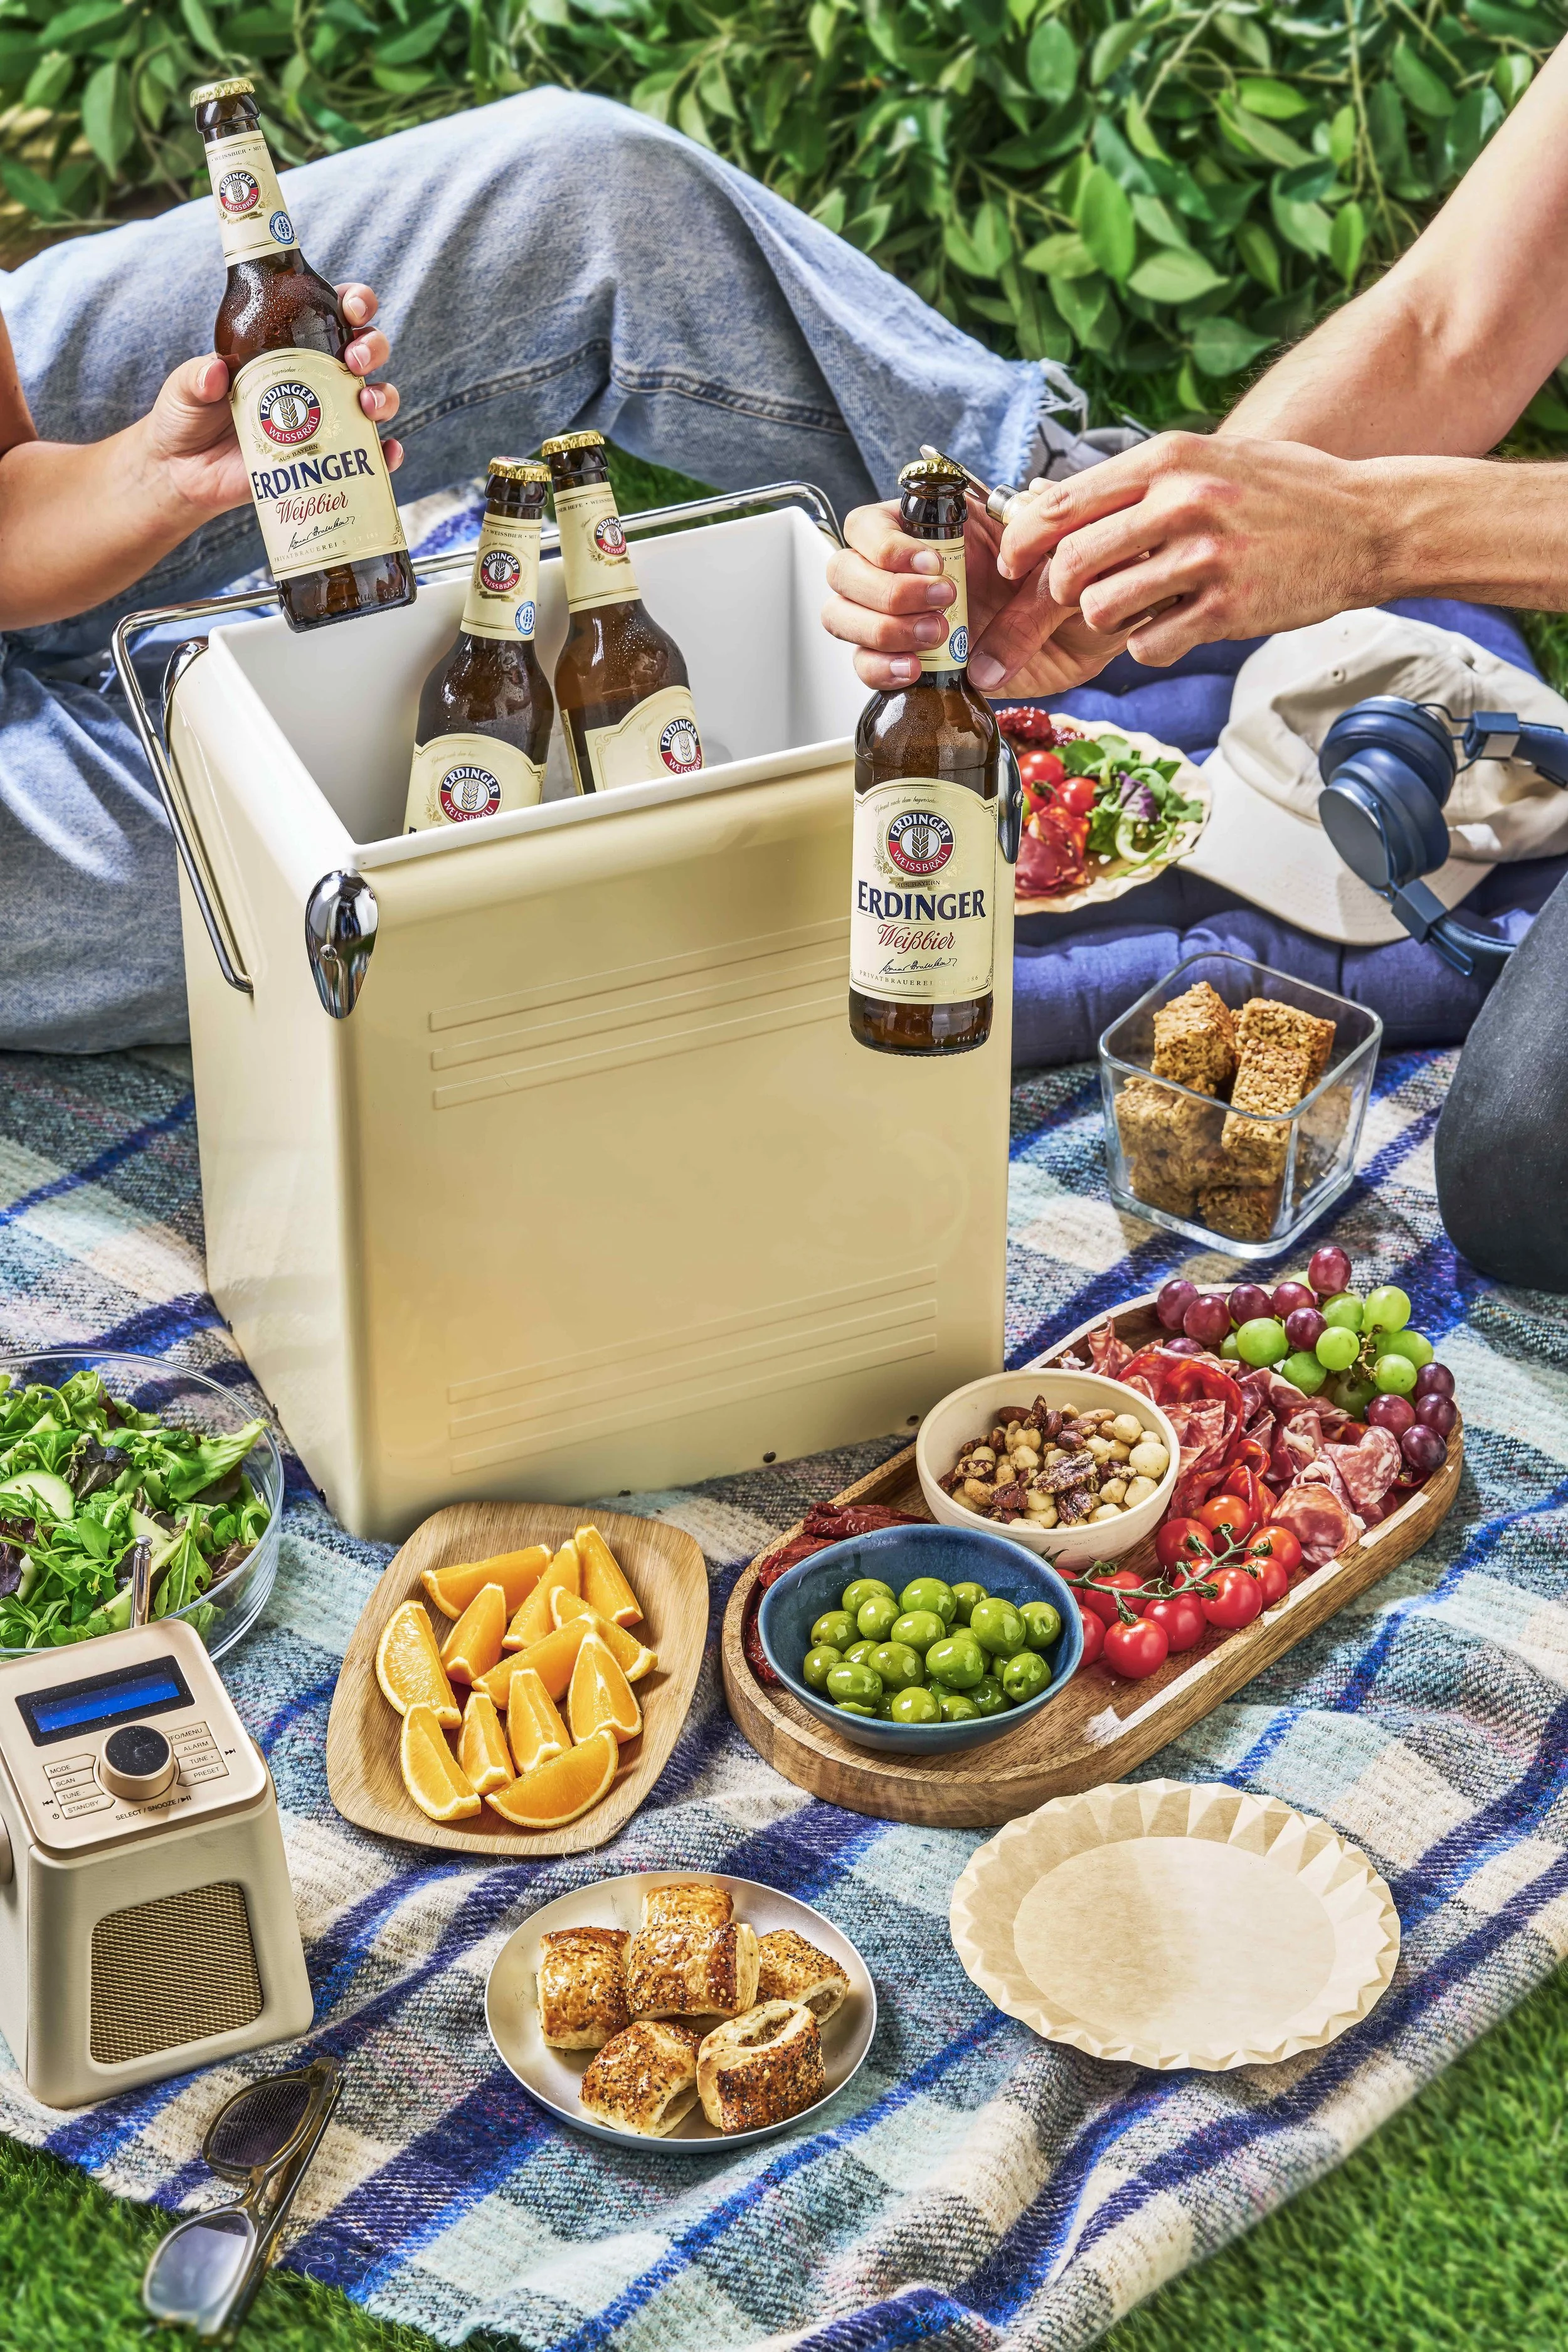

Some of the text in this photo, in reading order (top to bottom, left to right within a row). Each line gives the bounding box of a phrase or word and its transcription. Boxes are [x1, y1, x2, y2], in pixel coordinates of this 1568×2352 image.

[215, 149, 246, 161] WEISSBIER
[221, 172, 255, 194] ERDINGER
[225, 194, 257, 211] WEISSBRÄU
[260, 384, 314, 415] ERDINGER
[268, 416, 318, 442] WEISSBRÄU
[292, 444, 319, 457] BAYERN
[251, 448, 376, 501] ERDINGER
[275, 491, 349, 526] Weißbier
[490, 529, 522, 539] WEISSBIER
[274, 542, 338, 563] PRIVATBRAUEREI
[484, 553, 519, 571] ERDINGER
[483, 574, 516, 590] WEISSBRÄU
[661, 719, 698, 746] ERDINGER
[443, 768, 499, 795] ERDINGER
[890, 814, 951, 839] ERDINGER
[894, 850, 948, 872] WEISSBRÄU
[857, 879, 987, 921] ERDINGER
[877, 924, 956, 954] Weißbier
[859, 970, 933, 986] PRIVATBRAUEREI
[184, 1740, 209, 1752] ALARM
[189, 1755, 209, 1764] TUNE
[50, 1764, 72, 1774] MODE
[193, 1766, 220, 1778] PRESET
[56, 1777, 76, 1787] SCAN
[61, 1791, 81, 1801] TUNE
[68, 1800, 99, 1813] STANDBY
[115, 1809, 142, 1821] SELECT
[147, 1799, 176, 1812] SNOOZE
